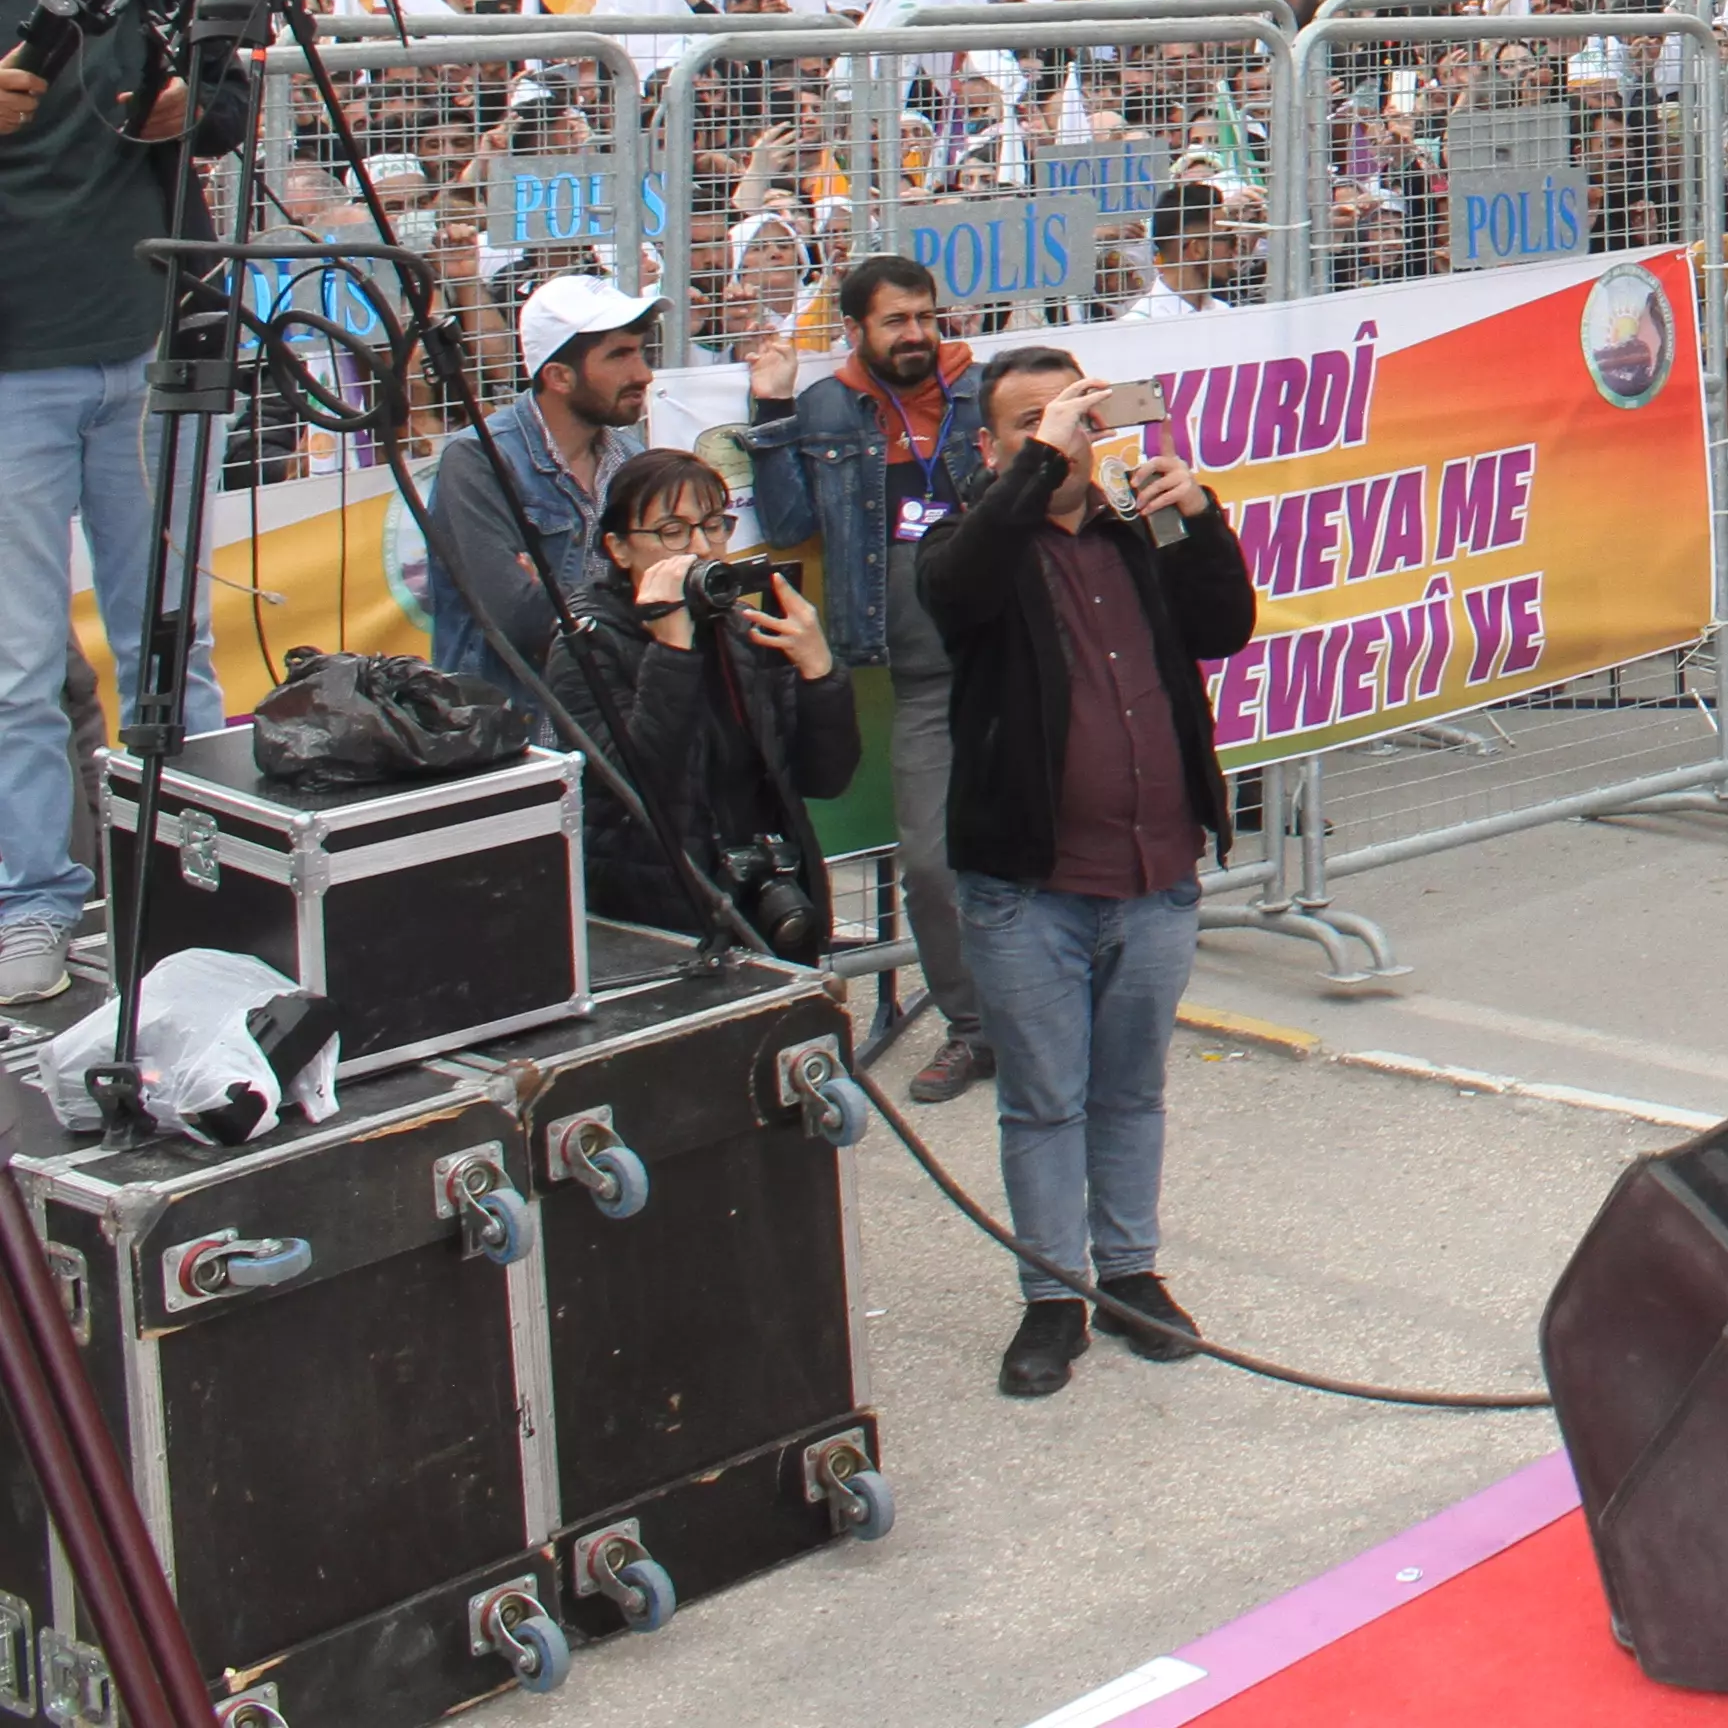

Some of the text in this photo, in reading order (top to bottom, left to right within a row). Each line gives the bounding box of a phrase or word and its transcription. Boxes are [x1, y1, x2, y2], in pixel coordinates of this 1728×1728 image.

[514, 172, 670, 242] POLS
[911, 203, 1069, 298] POLİS
[1465, 175, 1579, 260] POLİS
[226, 234, 378, 349] OLİS
[1145, 319, 1376, 468] KURDÎ
[1435, 445, 1536, 564] ME
[1464, 574, 1544, 684] YE
